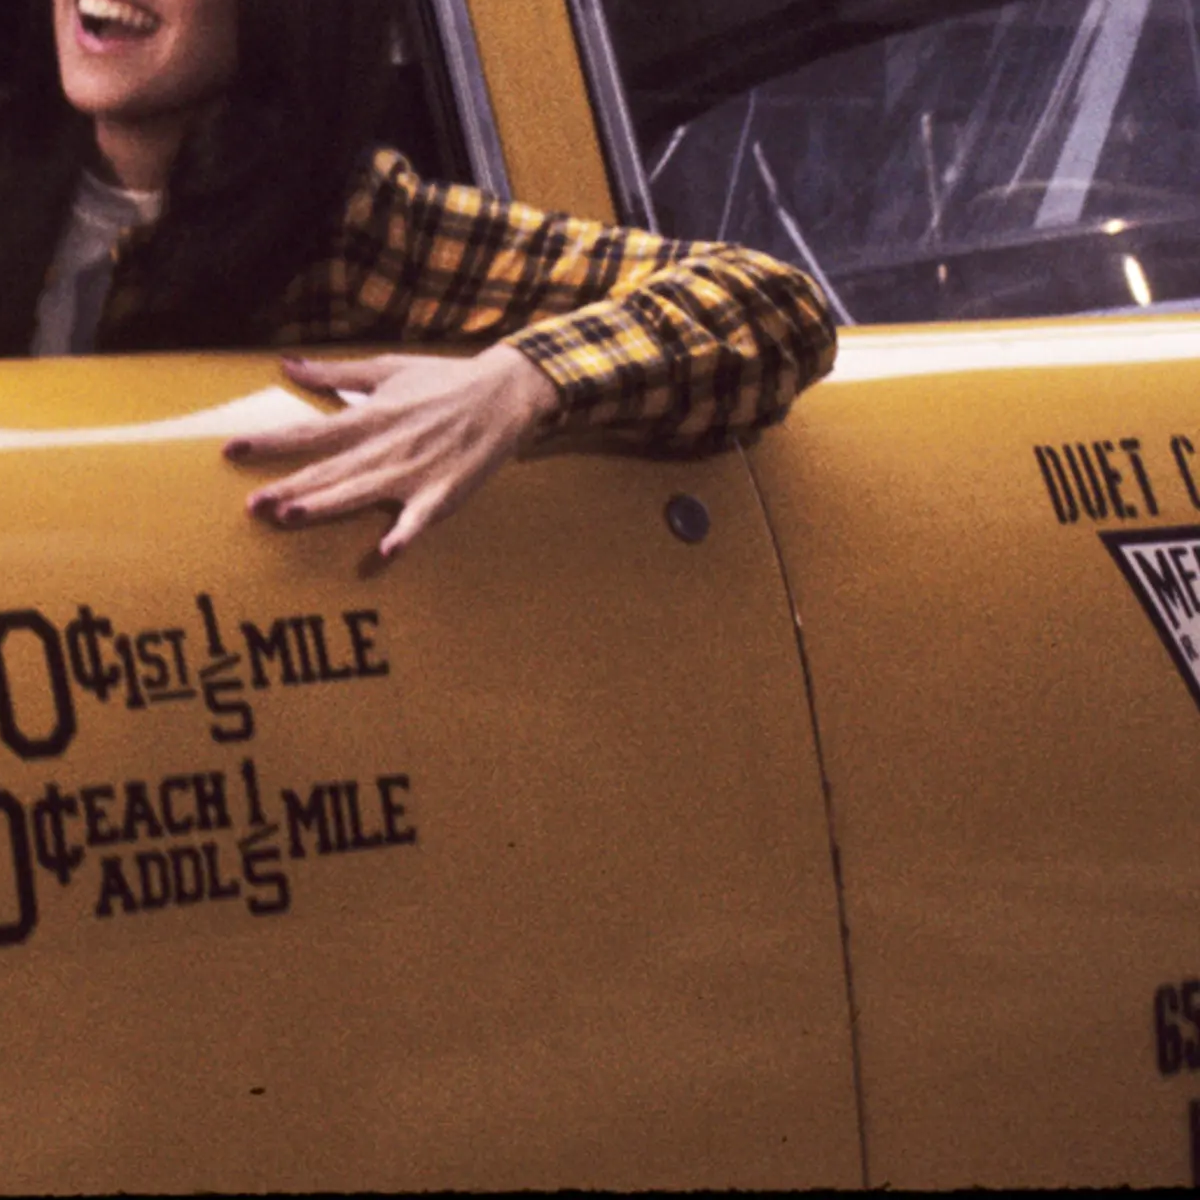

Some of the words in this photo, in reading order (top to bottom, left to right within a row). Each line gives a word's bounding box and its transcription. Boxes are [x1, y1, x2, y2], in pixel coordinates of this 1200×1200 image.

[1033, 437, 1159, 524] DUET
[241, 609, 391, 689] MILE
[80, 772, 232, 846] EACH
[281, 774, 417, 859] MILE
[95, 842, 241, 918] ADDL
